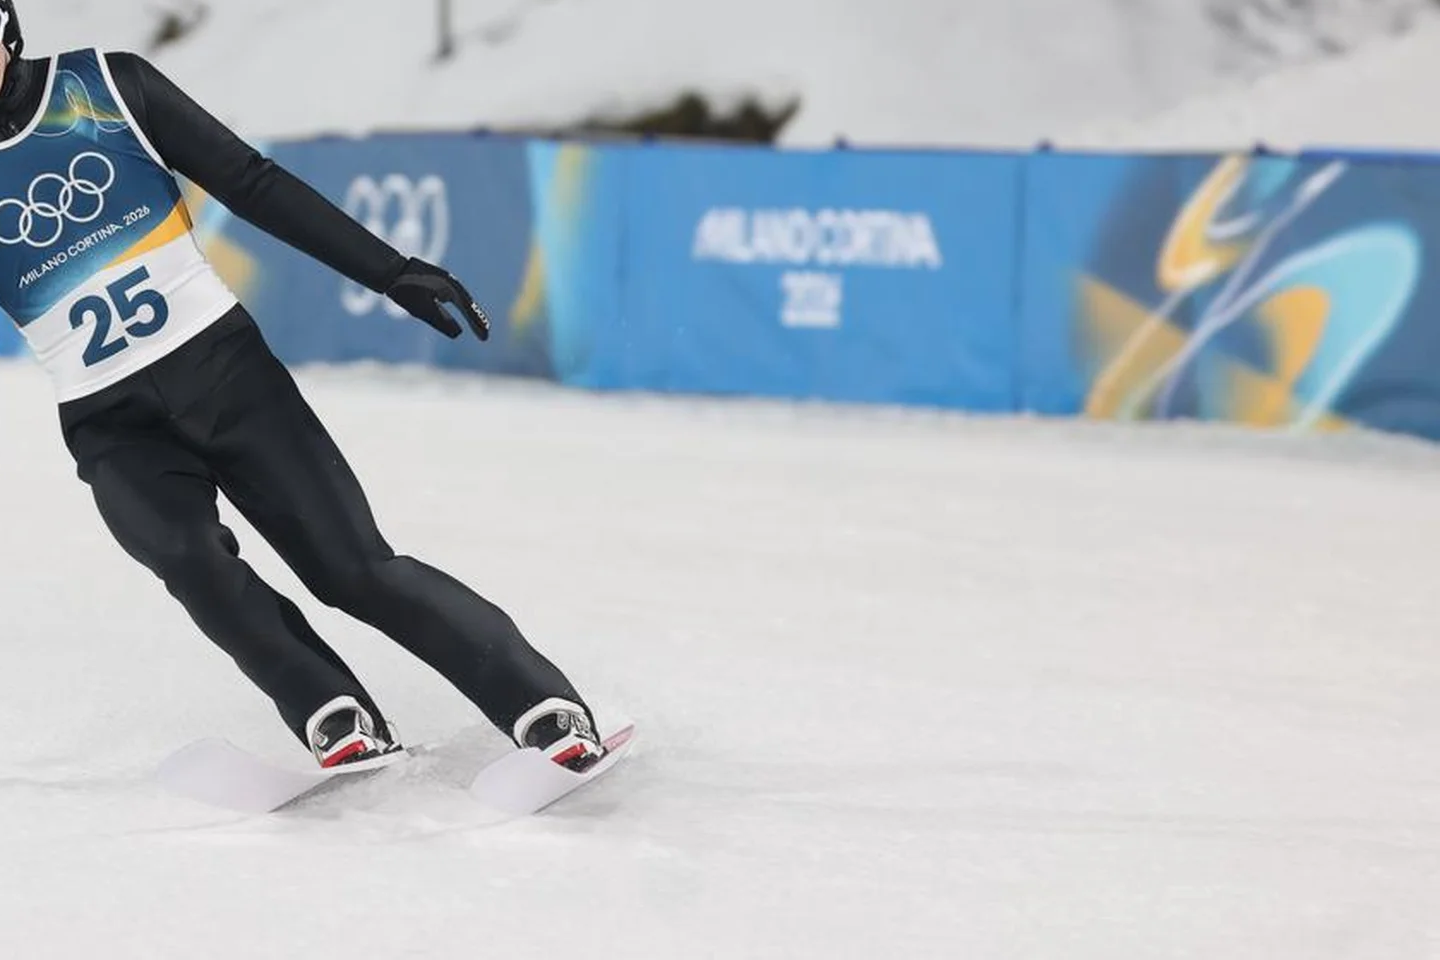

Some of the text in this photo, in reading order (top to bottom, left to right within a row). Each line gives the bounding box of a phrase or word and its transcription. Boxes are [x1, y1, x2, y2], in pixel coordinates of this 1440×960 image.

[19, 205, 150, 289] MILANO CORTINA 2026
[69, 265, 169, 368] 25
